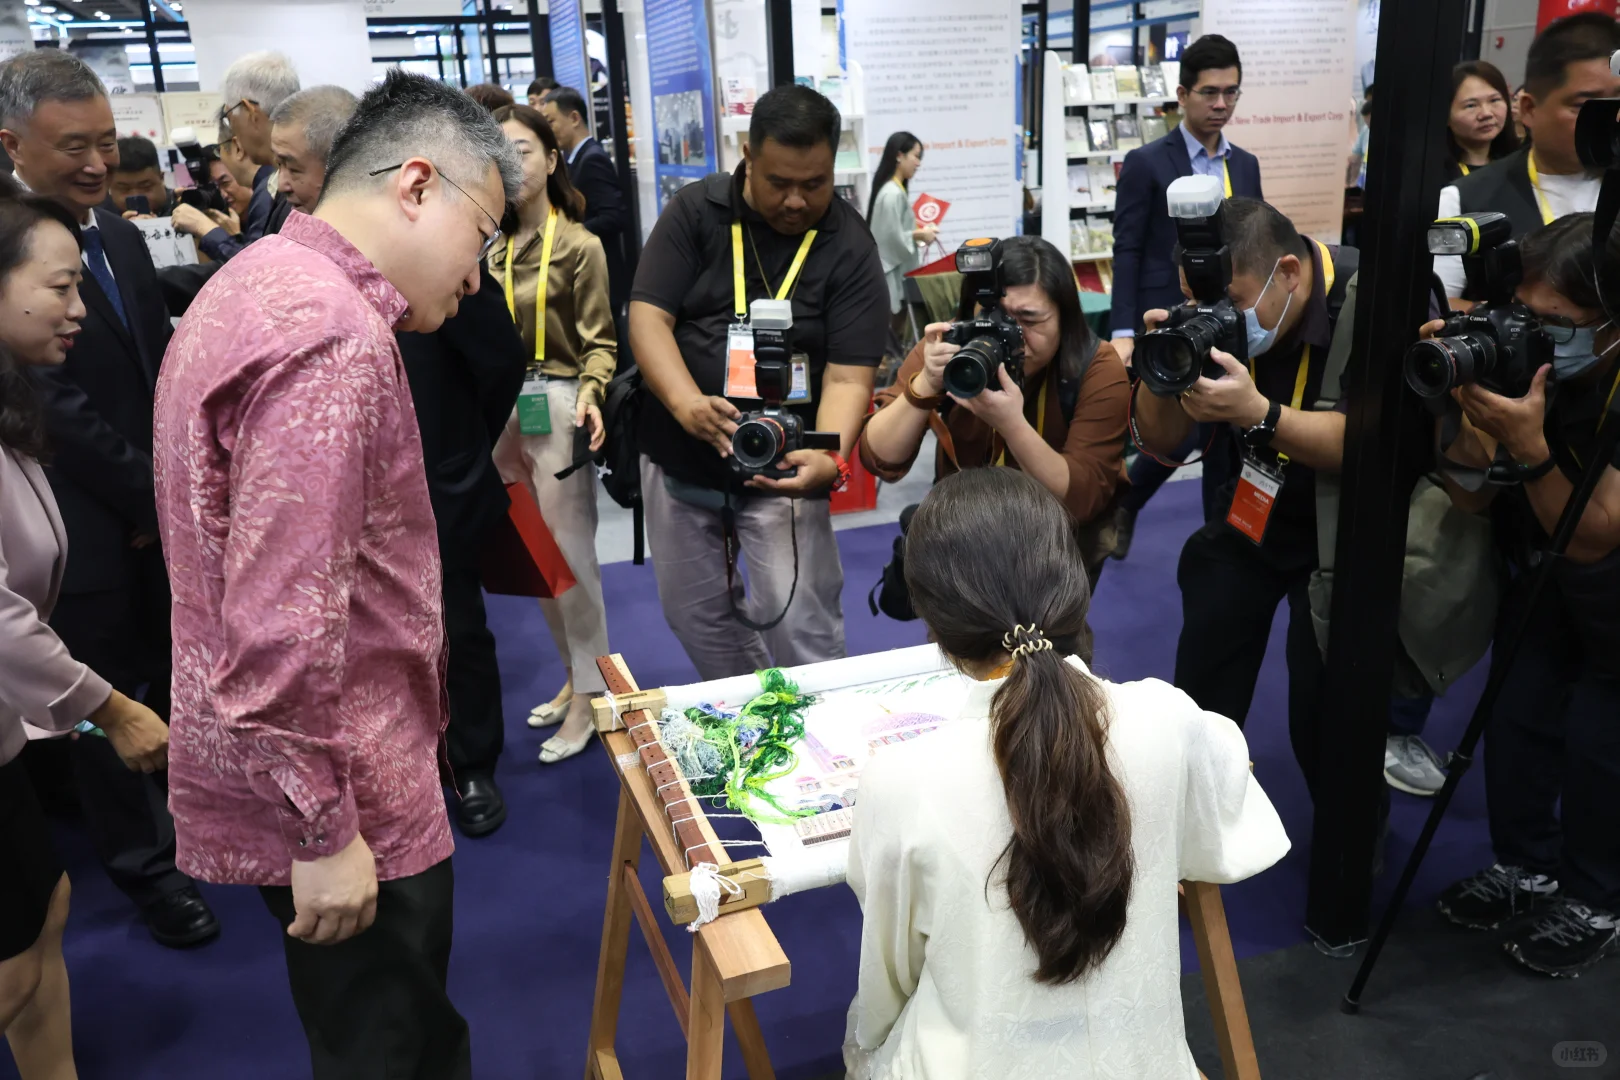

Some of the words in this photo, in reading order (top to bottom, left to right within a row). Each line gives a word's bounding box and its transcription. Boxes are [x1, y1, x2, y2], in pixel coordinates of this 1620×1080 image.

[1273, 114, 1295, 125] Import
[1297, 112, 1302, 122] &
[1304, 112, 1326, 122] Export
[932, 142, 955, 151] Import
[957, 139, 963, 149] &
[965, 138, 989, 149] Export
